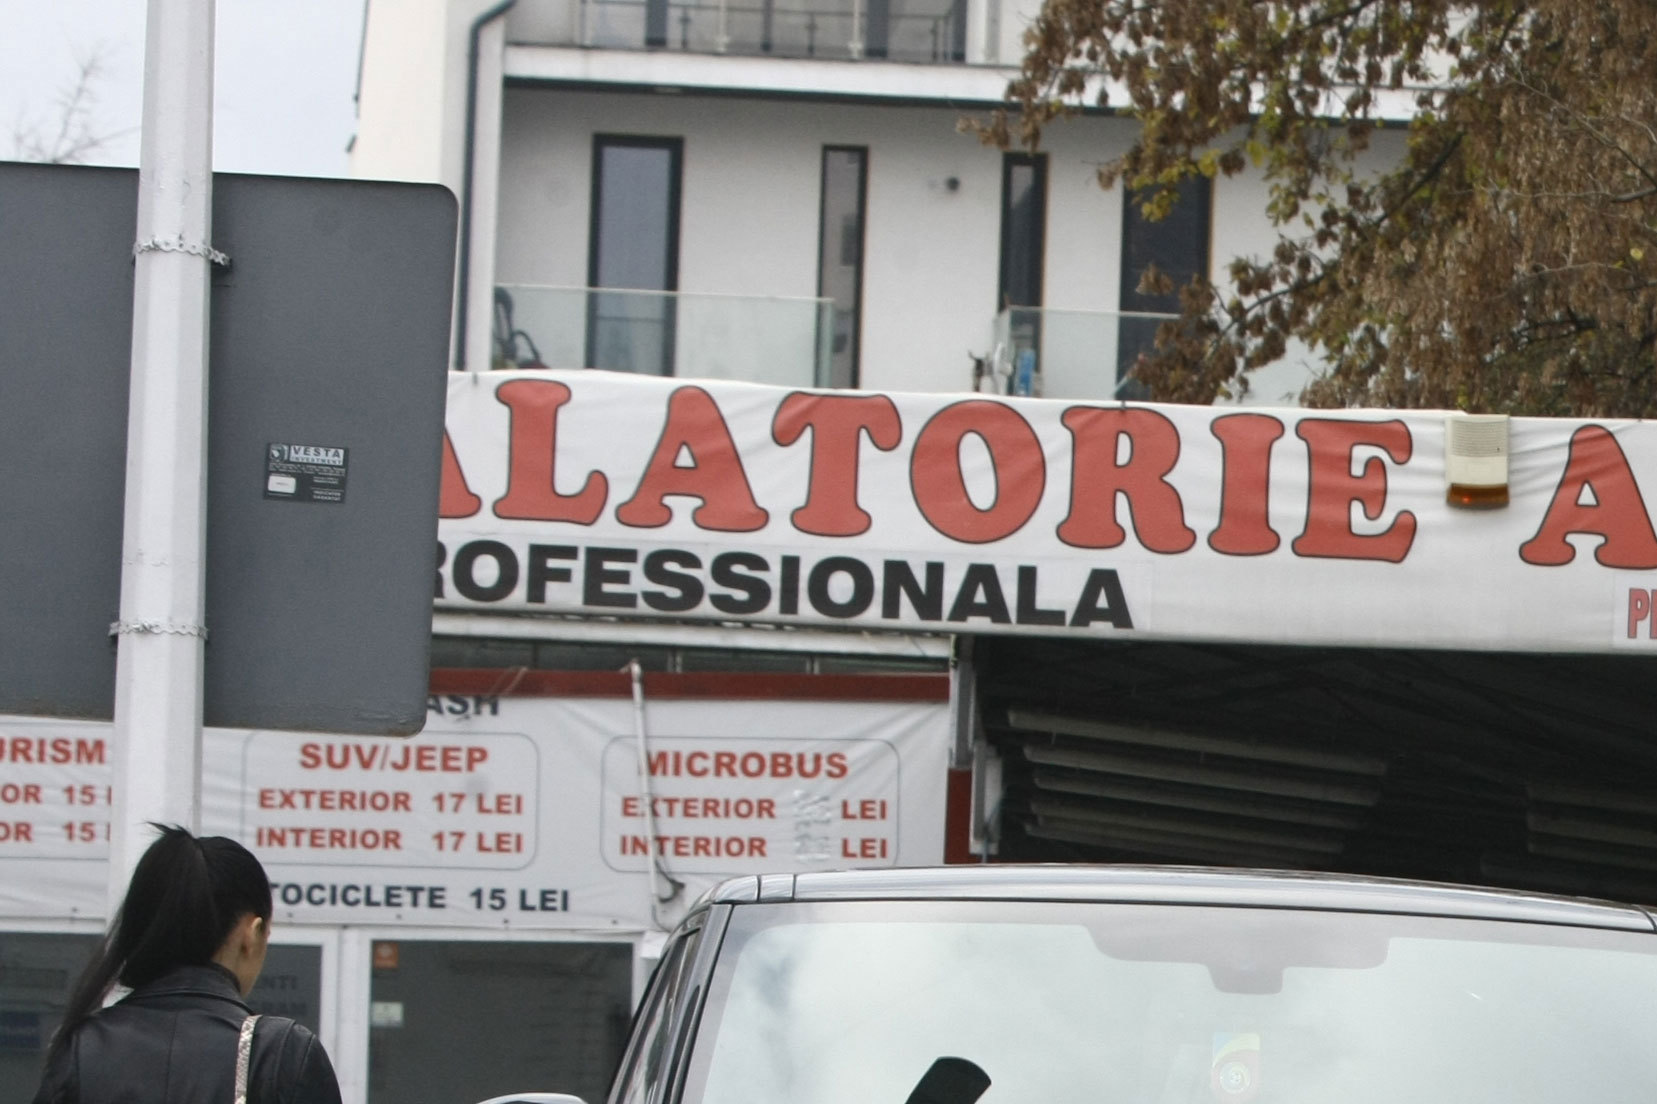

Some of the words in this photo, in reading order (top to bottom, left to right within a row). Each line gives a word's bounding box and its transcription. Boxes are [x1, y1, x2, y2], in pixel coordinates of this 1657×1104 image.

[293, 446, 340, 458] VESTA
[438, 378, 1418, 566] LATORIE
[0, 736, 105, 764] RISM
[299, 743, 488, 773] SUV/JEEP
[641, 751, 848, 779] MICROBUS
[62, 784, 96, 805] 15
[258, 788, 412, 813] EXTERIOR
[432, 792, 465, 814] 17
[476, 793, 523, 815] LEI
[841, 799, 888, 820] LEI
[62, 822, 96, 843] 15
[256, 828, 402, 850] INTERIOR
[432, 831, 465, 853] 17
[476, 832, 523, 853] LEI
[619, 835, 768, 858] INTERIOR
[841, 838, 888, 858] LEI
[470, 886, 506, 911] 15
[518, 887, 569, 912] LEI
